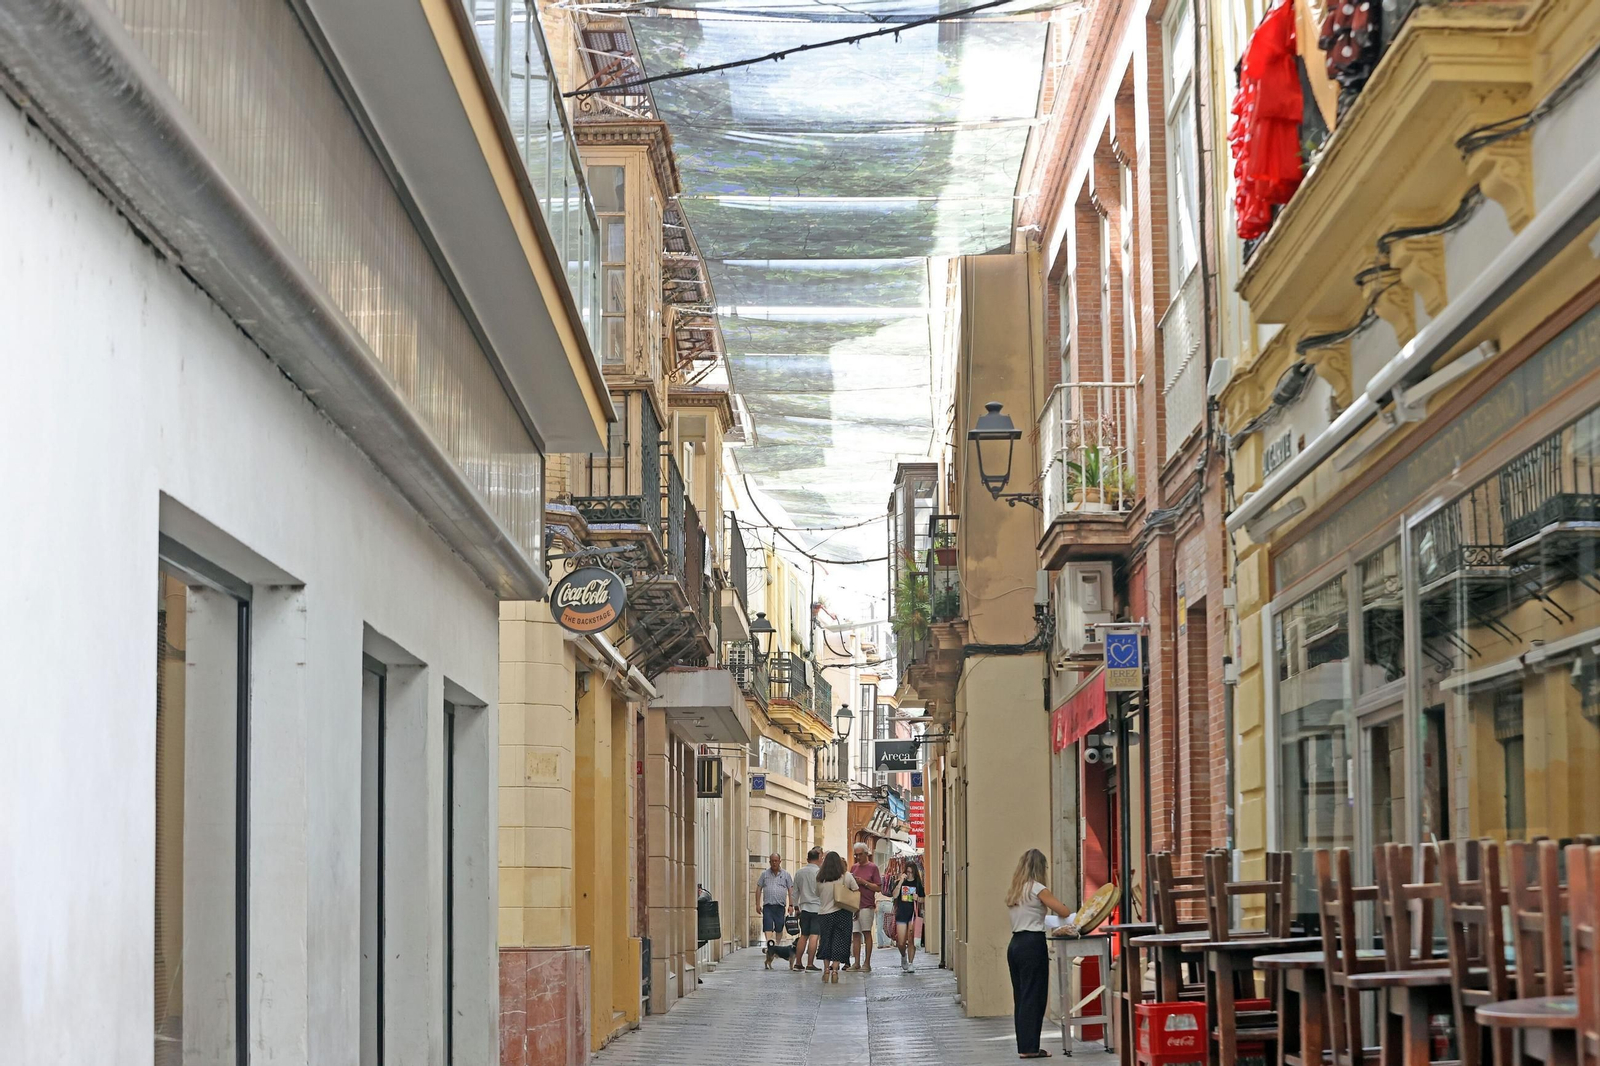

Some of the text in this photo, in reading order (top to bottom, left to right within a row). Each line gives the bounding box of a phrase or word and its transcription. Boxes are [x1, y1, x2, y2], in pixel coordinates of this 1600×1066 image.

[557, 578, 612, 608] Coca-Cola
[1109, 669, 1137, 678] JEREZ
[881, 751, 910, 761] Areca
